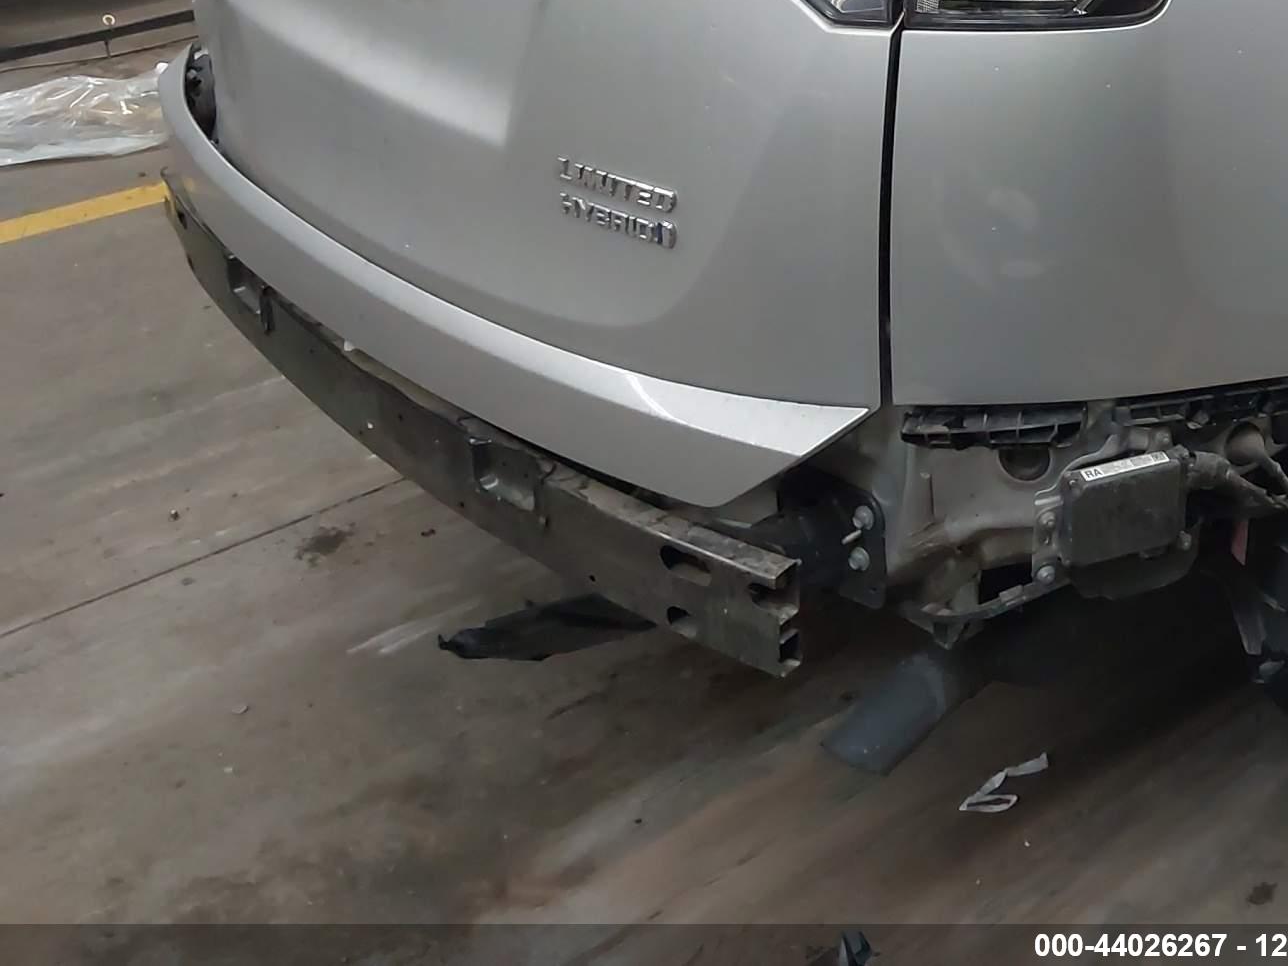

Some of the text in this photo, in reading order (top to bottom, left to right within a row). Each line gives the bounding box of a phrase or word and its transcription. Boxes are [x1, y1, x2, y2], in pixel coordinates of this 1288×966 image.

[557, 156, 678, 213] LIMITED
[559, 191, 678, 250] HYBRID
[1084, 468, 1102, 479] RA
